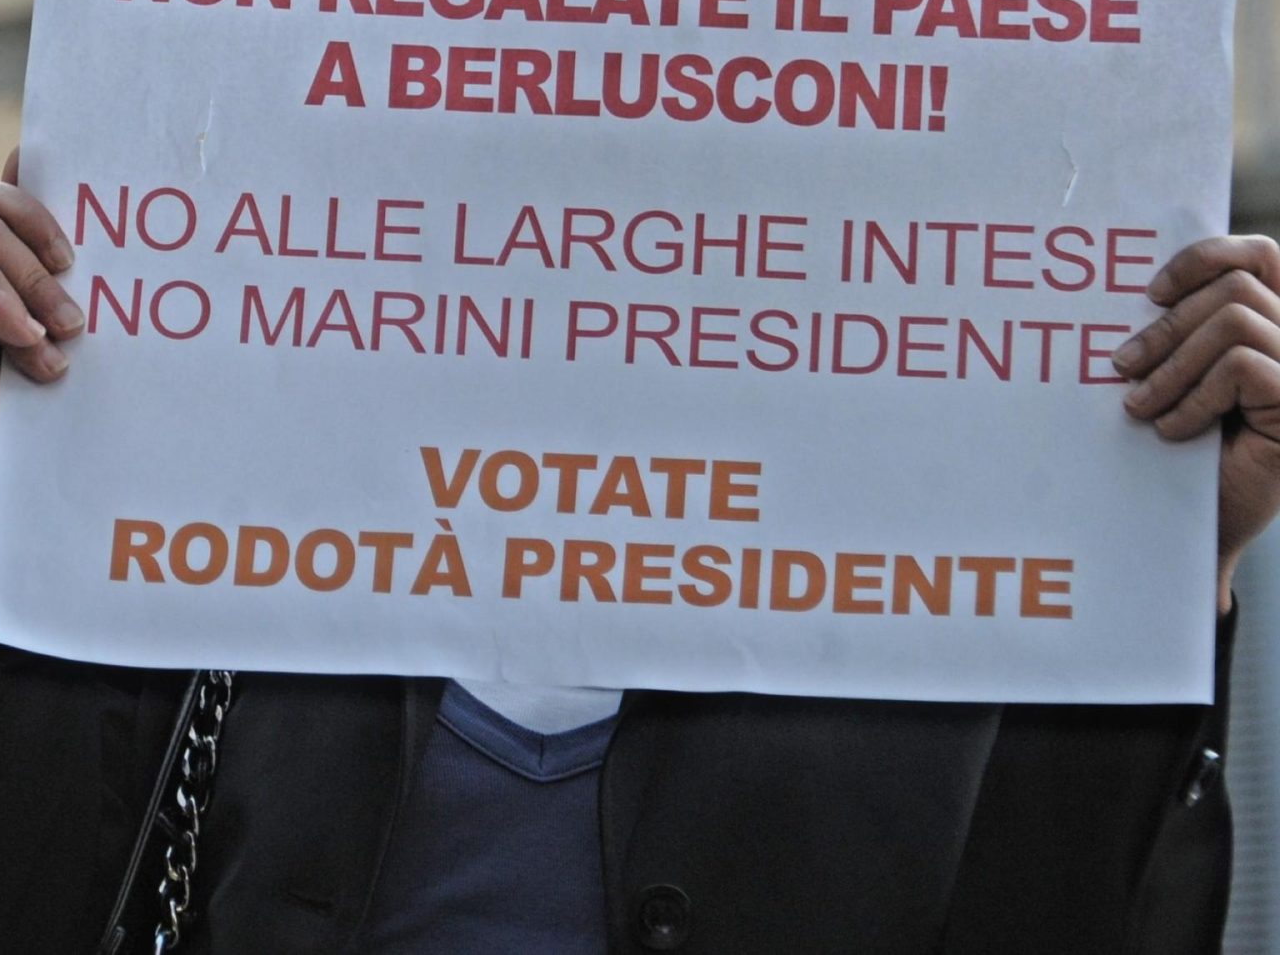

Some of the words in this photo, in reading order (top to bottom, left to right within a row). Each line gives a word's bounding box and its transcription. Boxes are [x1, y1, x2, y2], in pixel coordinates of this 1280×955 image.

[305, 42, 365, 107] A
[390, 48, 947, 130] BERLUSCONI!
[76, 182, 197, 253] NO
[216, 192, 425, 263] ALLE
[455, 202, 809, 280] LARGHE
[841, 221, 1157, 293] INTESE
[86, 275, 213, 341] NO
[241, 285, 534, 360] MARINI
[566, 301, 1131, 385] PRESIDENTE
[421, 447, 762, 522] VOTATE
[111, 519, 472, 597] RODOTÀ
[503, 540, 1075, 618] PRESIDENTE
